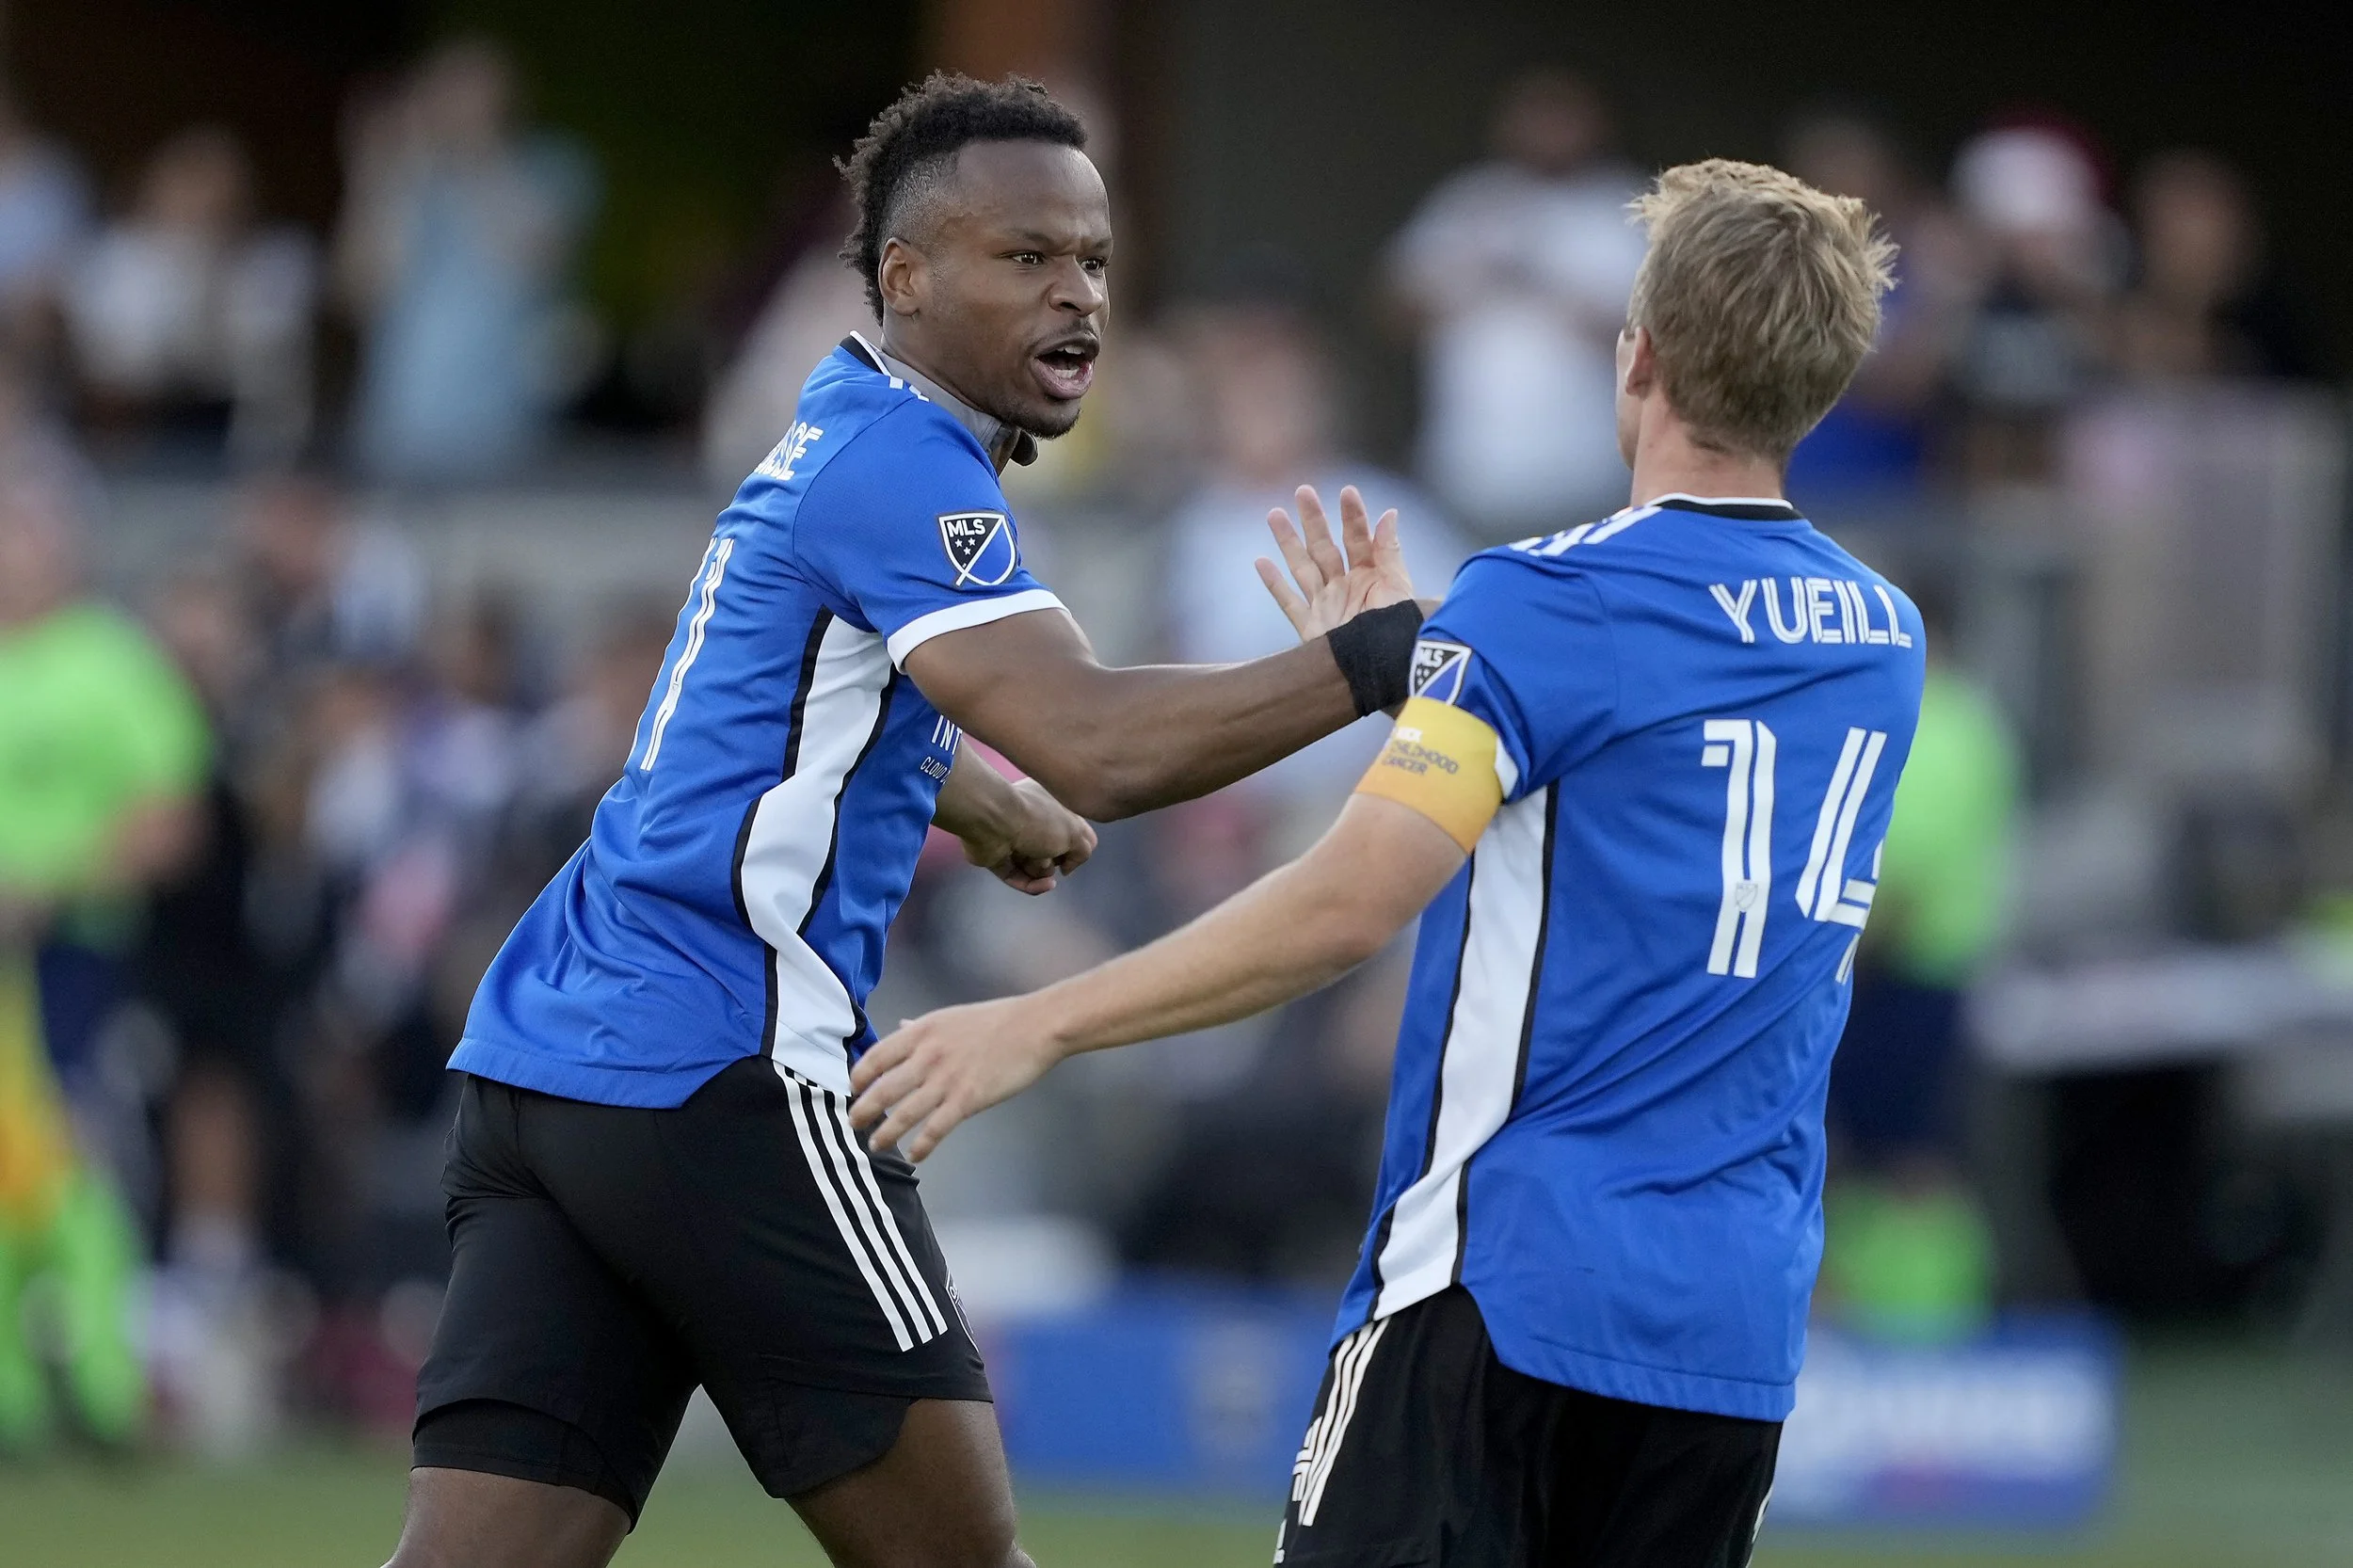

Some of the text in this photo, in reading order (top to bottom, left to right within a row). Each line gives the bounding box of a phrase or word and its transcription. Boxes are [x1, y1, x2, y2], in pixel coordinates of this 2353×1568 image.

[946, 519, 985, 537] MLS
[1708, 576, 1913, 648] YUEILL
[920, 756, 948, 779] CLOUD
[1701, 718, 1888, 985] 14
